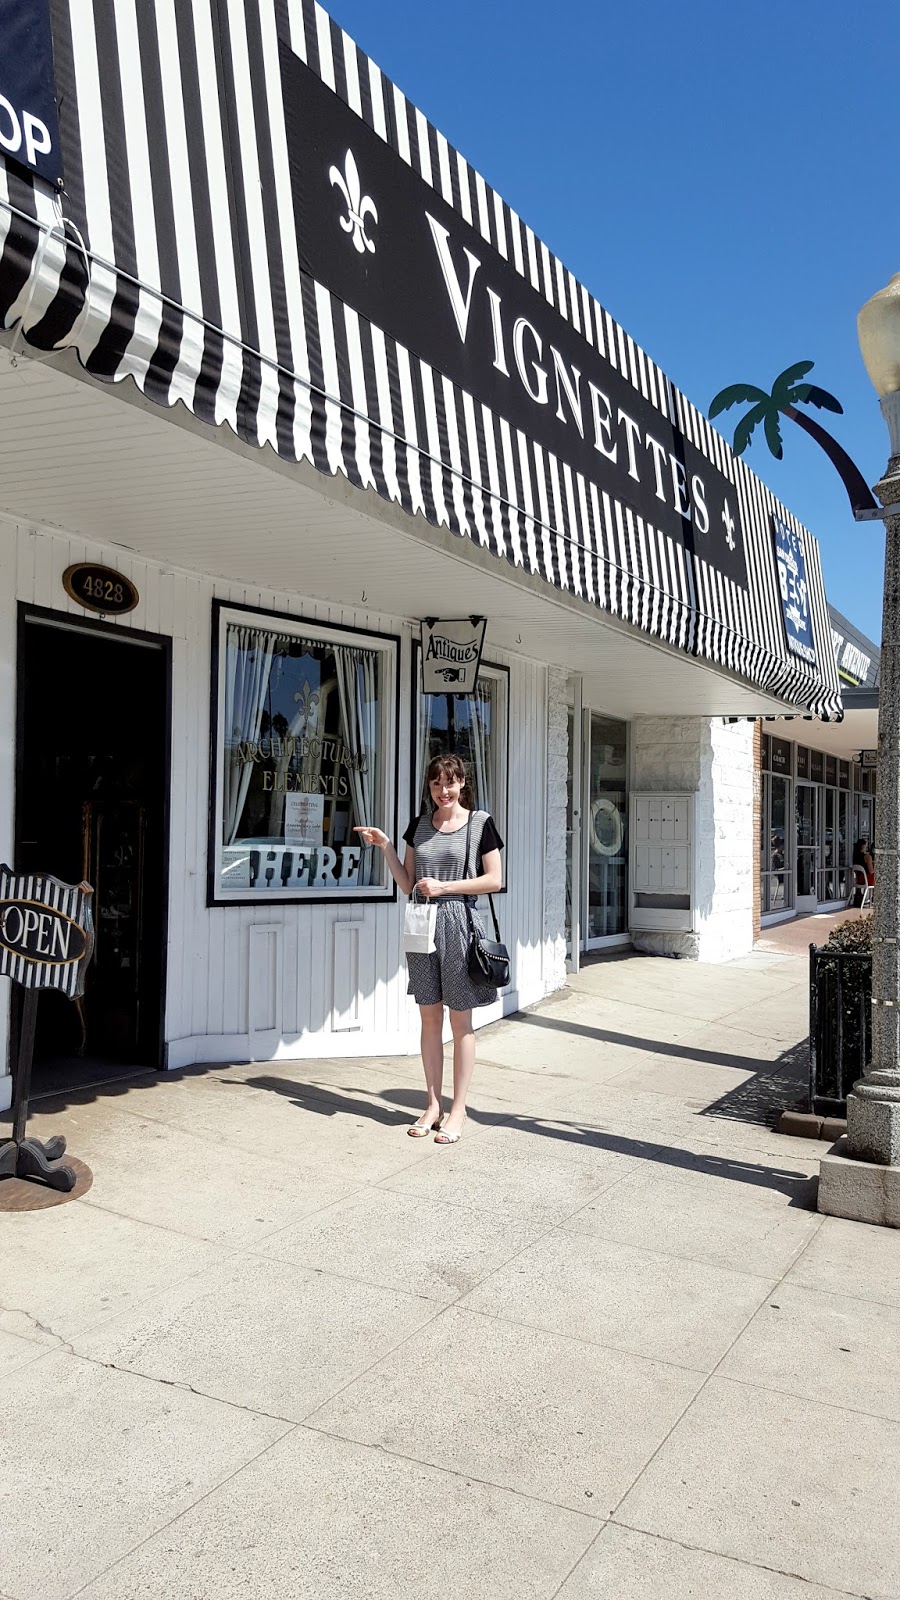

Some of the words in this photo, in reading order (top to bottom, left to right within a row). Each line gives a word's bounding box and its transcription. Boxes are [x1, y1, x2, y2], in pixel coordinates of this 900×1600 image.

[424, 210, 710, 535] VIGNETTES
[83, 575, 124, 603] 4828
[777, 560, 808, 617] BEST
[425, 633, 479, 662] Antiques
[235, 736, 369, 775] ARCHITECTURAL
[262, 770, 348, 796] ELEMENTS
[2, 905, 72, 959] OPEN
